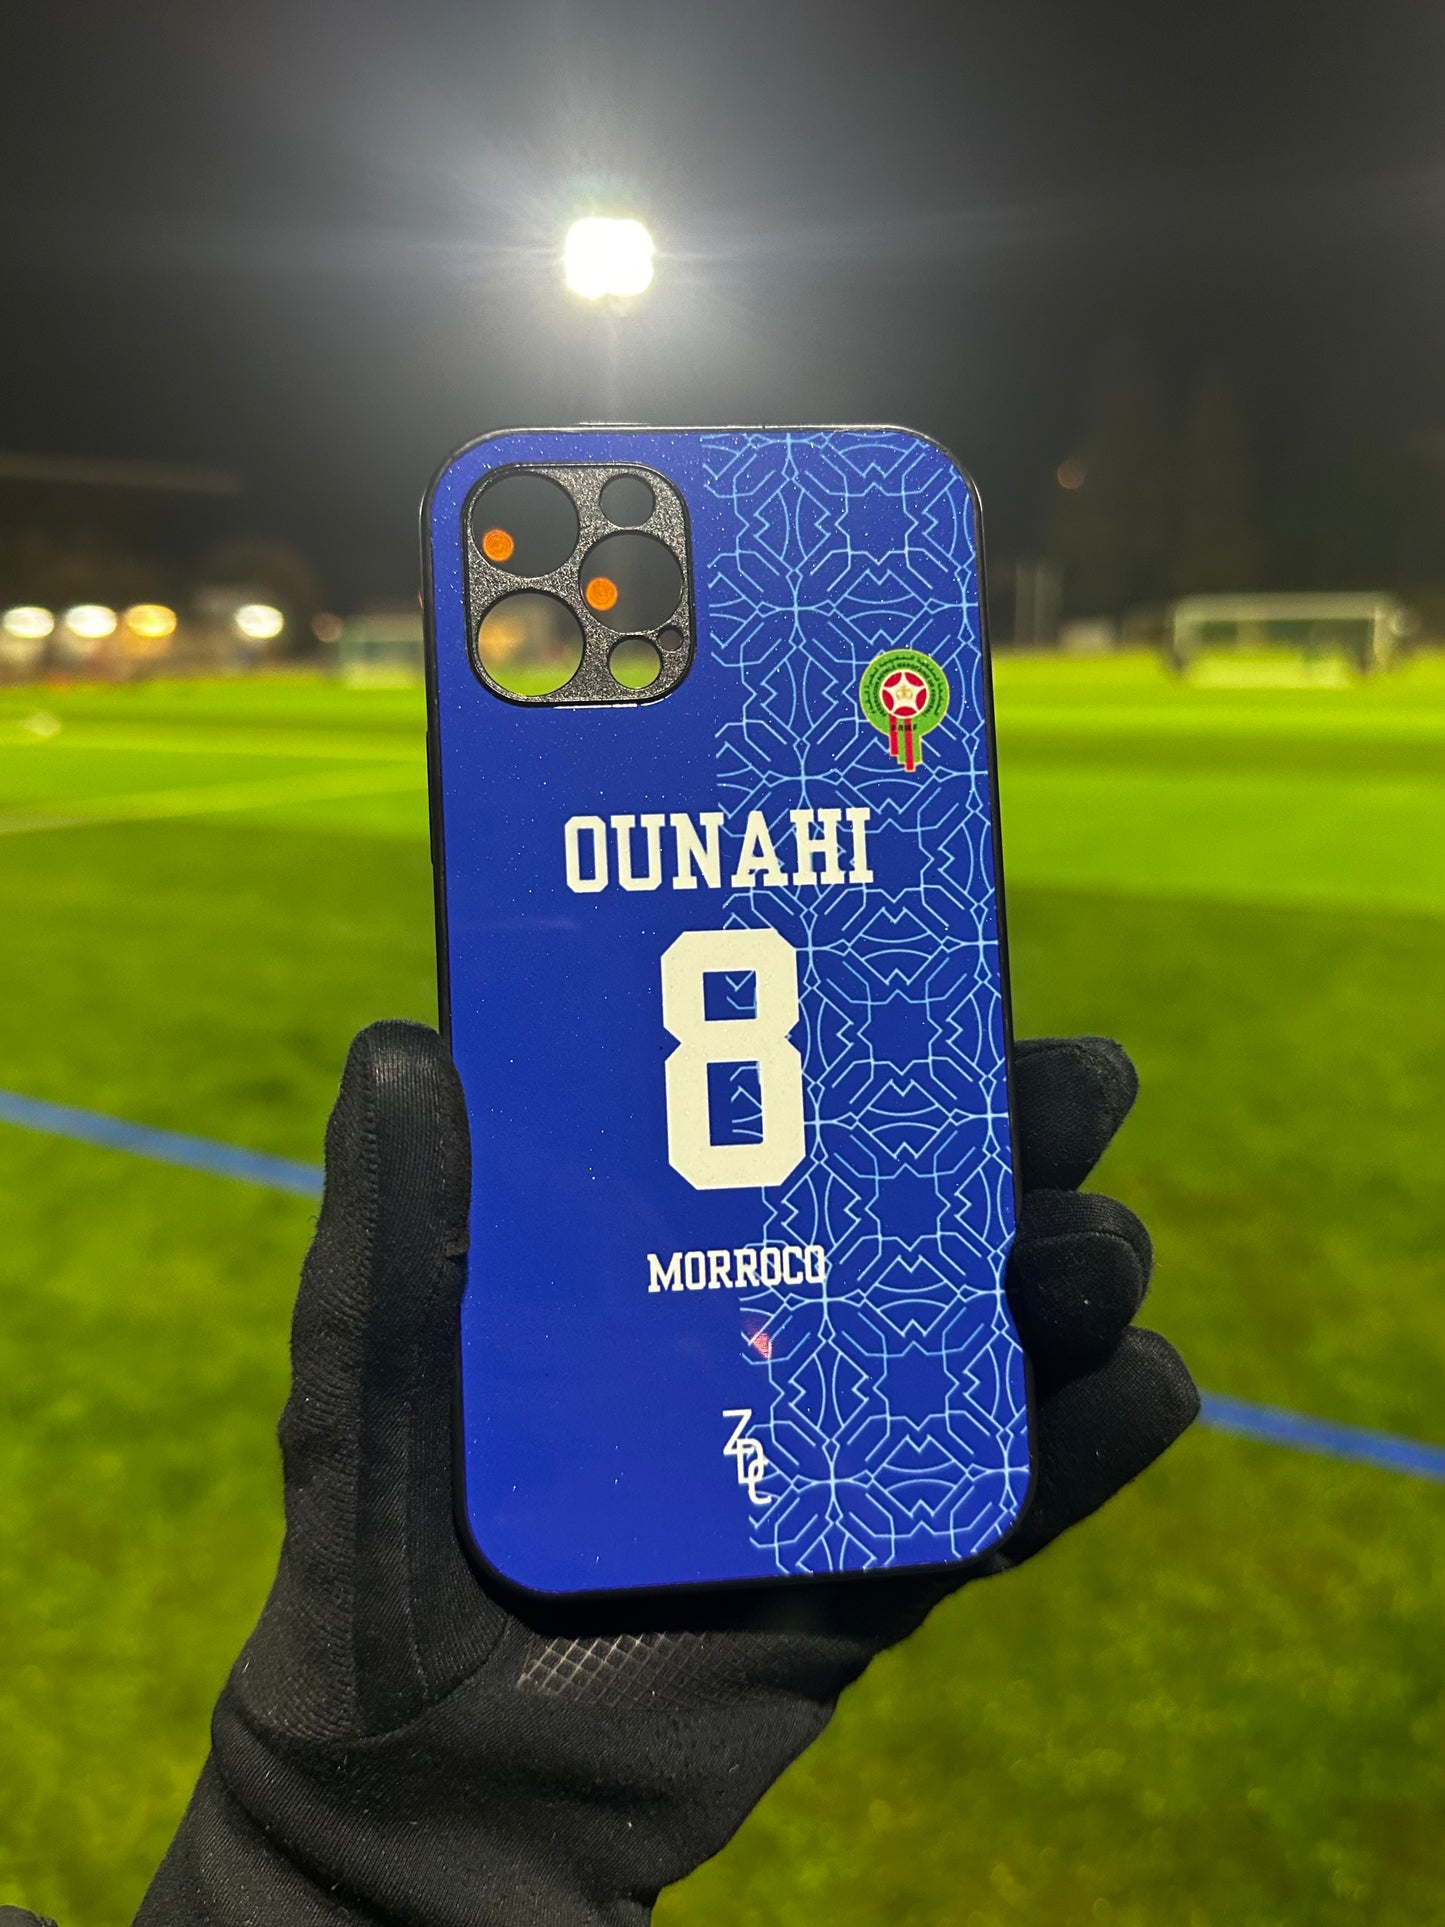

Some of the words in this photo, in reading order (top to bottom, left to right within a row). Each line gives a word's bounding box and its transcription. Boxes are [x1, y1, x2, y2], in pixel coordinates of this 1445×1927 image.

[564, 806, 874, 893] OUNAHI
[661, 928, 807, 1191] 8
[646, 1244, 826, 1293] MORROCO
